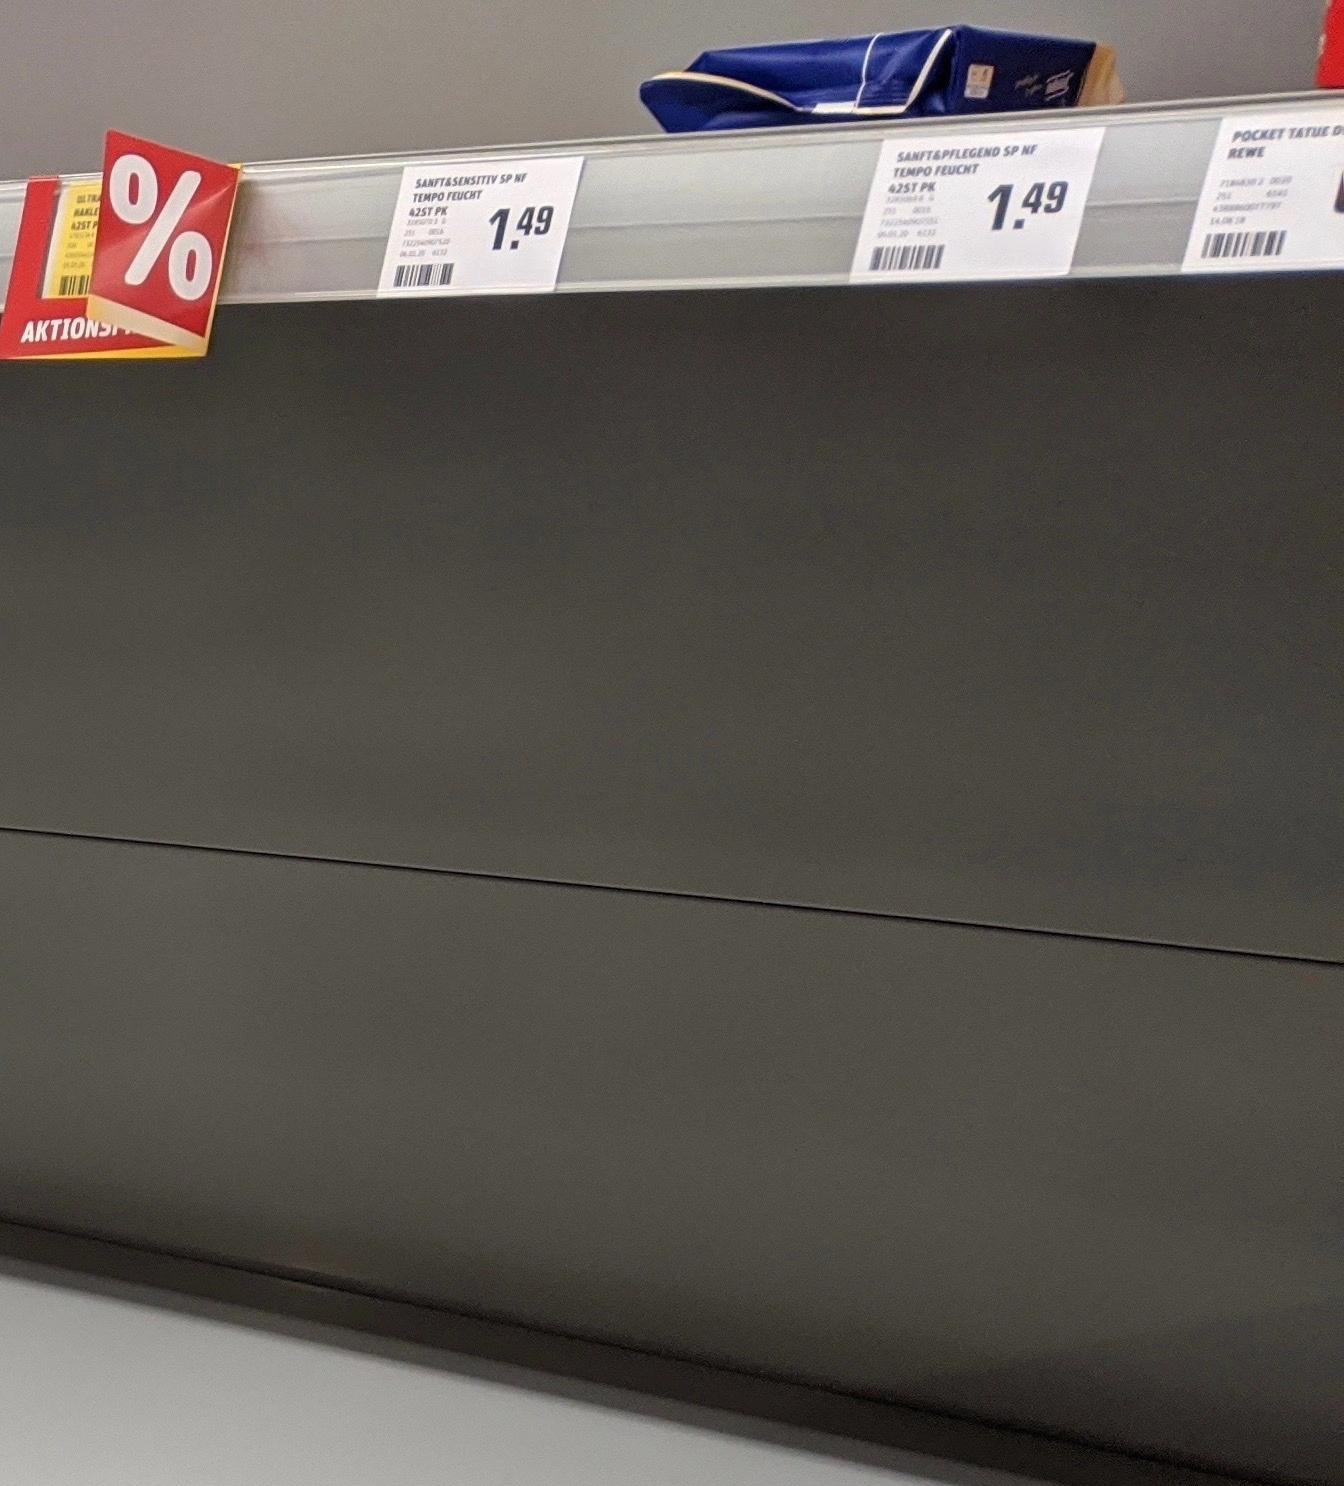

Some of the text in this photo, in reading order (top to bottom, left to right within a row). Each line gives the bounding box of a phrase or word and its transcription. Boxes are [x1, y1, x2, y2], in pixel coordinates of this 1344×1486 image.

[1232, 124, 1344, 143] POCKET TATUE D
[897, 143, 1039, 163] SANFT&PFLEGEND SP NF
[1227, 146, 1266, 160] REWE
[893, 163, 979, 178] TEMPO FEUCHT
[415, 172, 528, 189] SANFT&SENSITIV SP NF
[888, 181, 937, 194] 42ST PK
[412, 189, 483, 203] TEMPO FEUCHT
[409, 206, 449, 217] 42ST PK
[987, 180, 1069, 231] 1.49
[109, 153, 213, 301] %
[489, 205, 554, 251] 1.49
